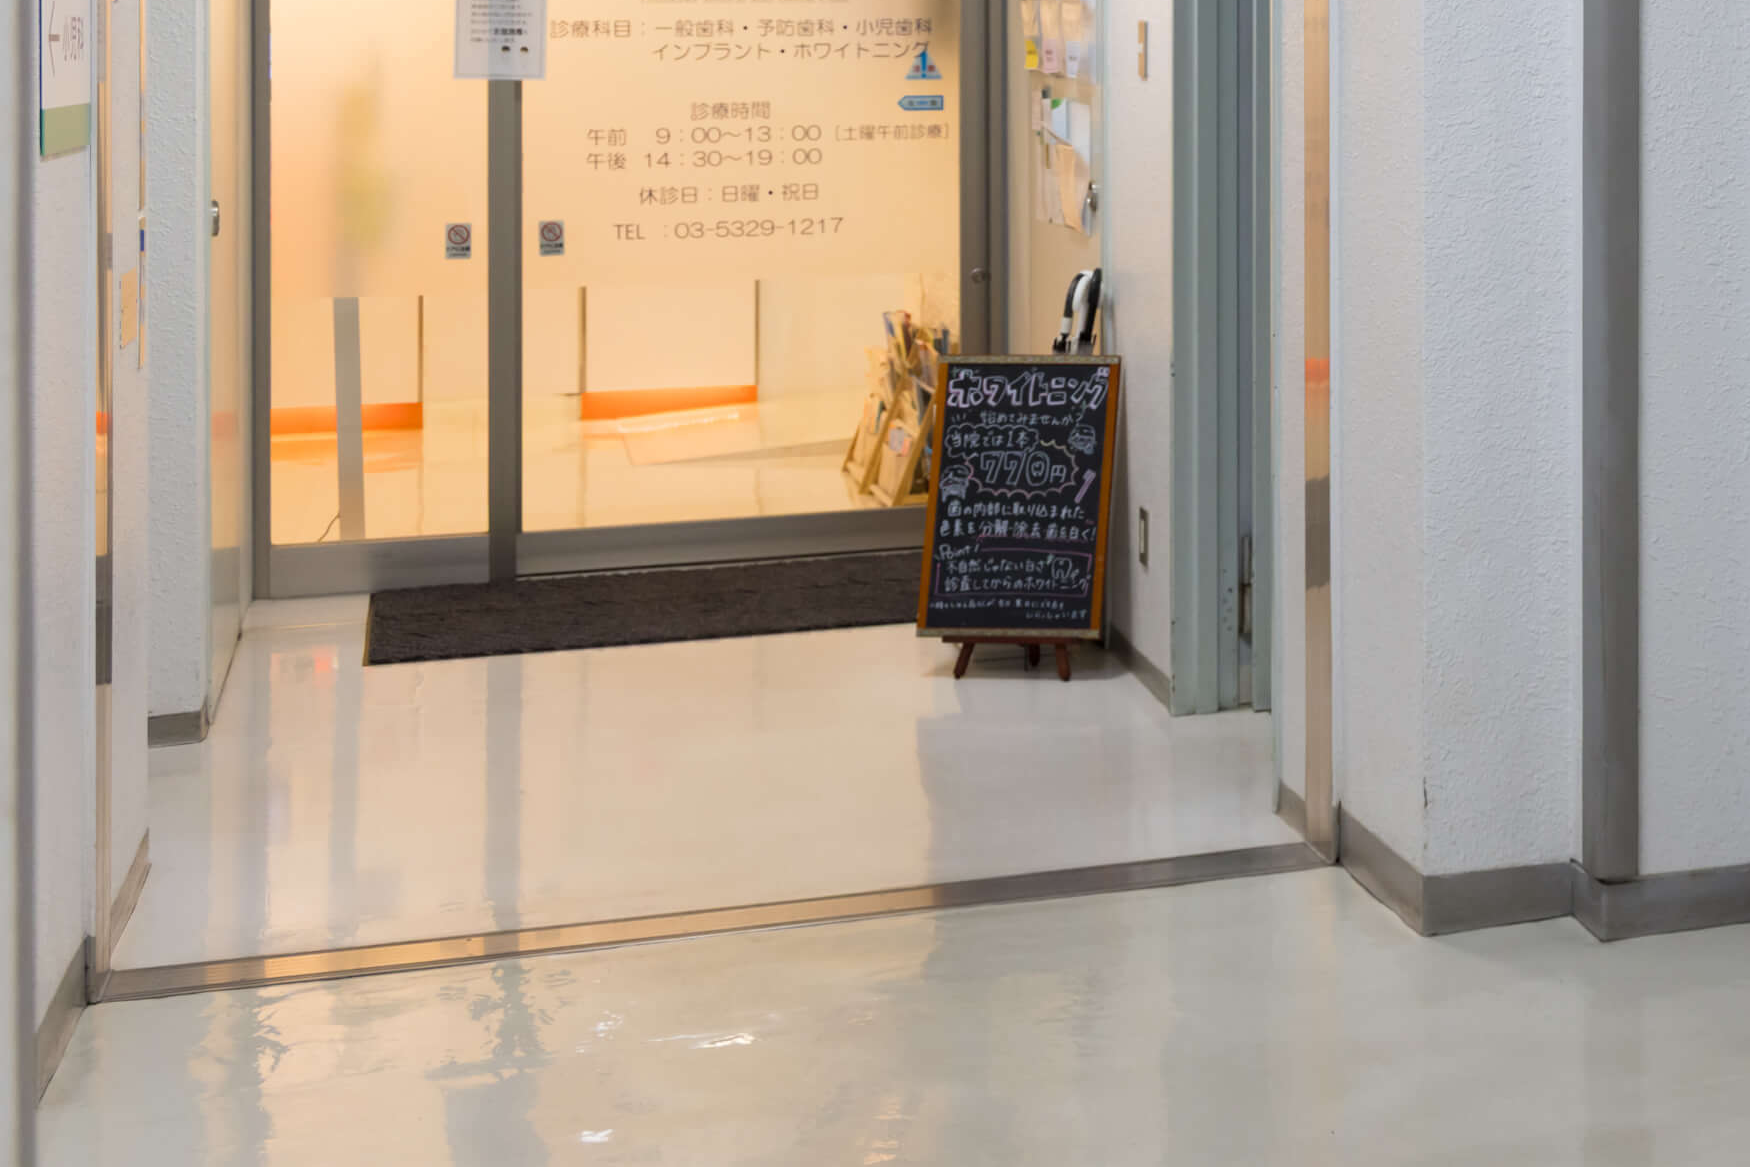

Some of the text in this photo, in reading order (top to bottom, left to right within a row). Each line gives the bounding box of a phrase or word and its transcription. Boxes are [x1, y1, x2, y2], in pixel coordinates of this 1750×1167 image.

[690, 101, 772, 121] 診療時間
[586, 127, 628, 148] 午前
[586, 151, 628, 171] 午後
[613, 223, 646, 241] TEL
[946, 366, 1111, 410] ホワイトニング
[980, 450, 1067, 486] 770円
